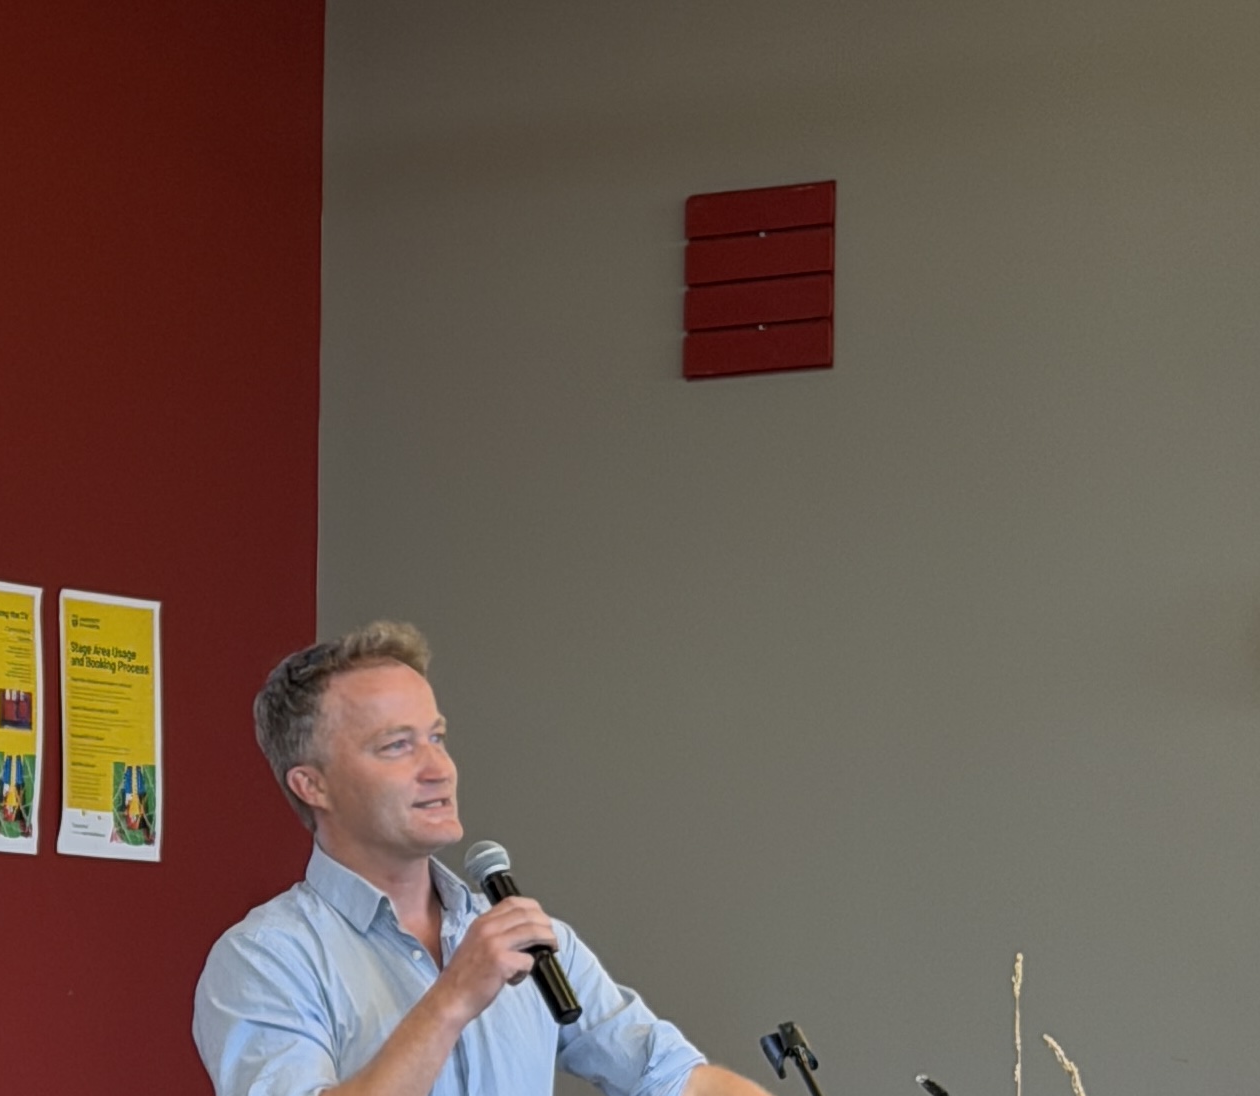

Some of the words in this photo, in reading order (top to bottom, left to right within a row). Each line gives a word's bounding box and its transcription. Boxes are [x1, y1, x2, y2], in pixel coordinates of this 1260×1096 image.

[70, 641, 92, 657] Stage
[93, 645, 111, 657] Area
[111, 646, 137, 662] Usage
[71, 656, 85, 667] and
[85, 656, 116, 674] Booking
[117, 660, 150, 675] Process
